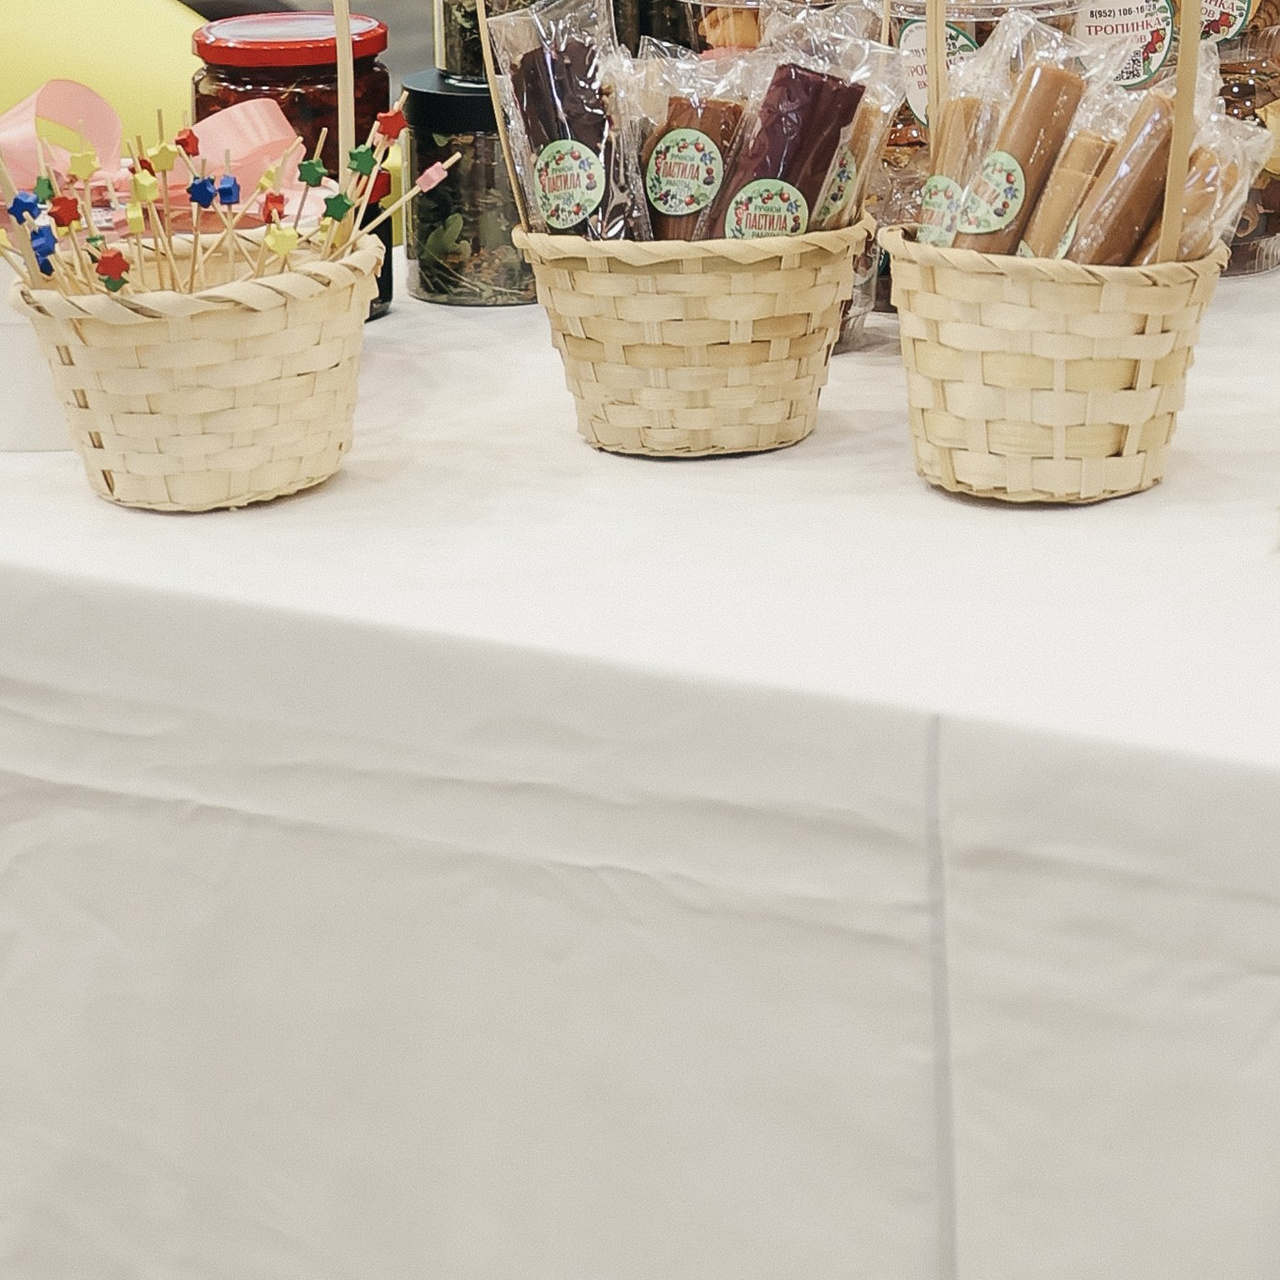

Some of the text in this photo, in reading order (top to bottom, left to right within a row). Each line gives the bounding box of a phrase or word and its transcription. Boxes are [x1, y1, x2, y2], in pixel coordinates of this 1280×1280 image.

[1085, 17, 1162, 36] ТРОПИНКА
[661, 160, 700, 181] ПАСТИЛА
[546, 172, 582, 194] ПАСТИЛА
[745, 212, 788, 231] ПАСТИЛА
